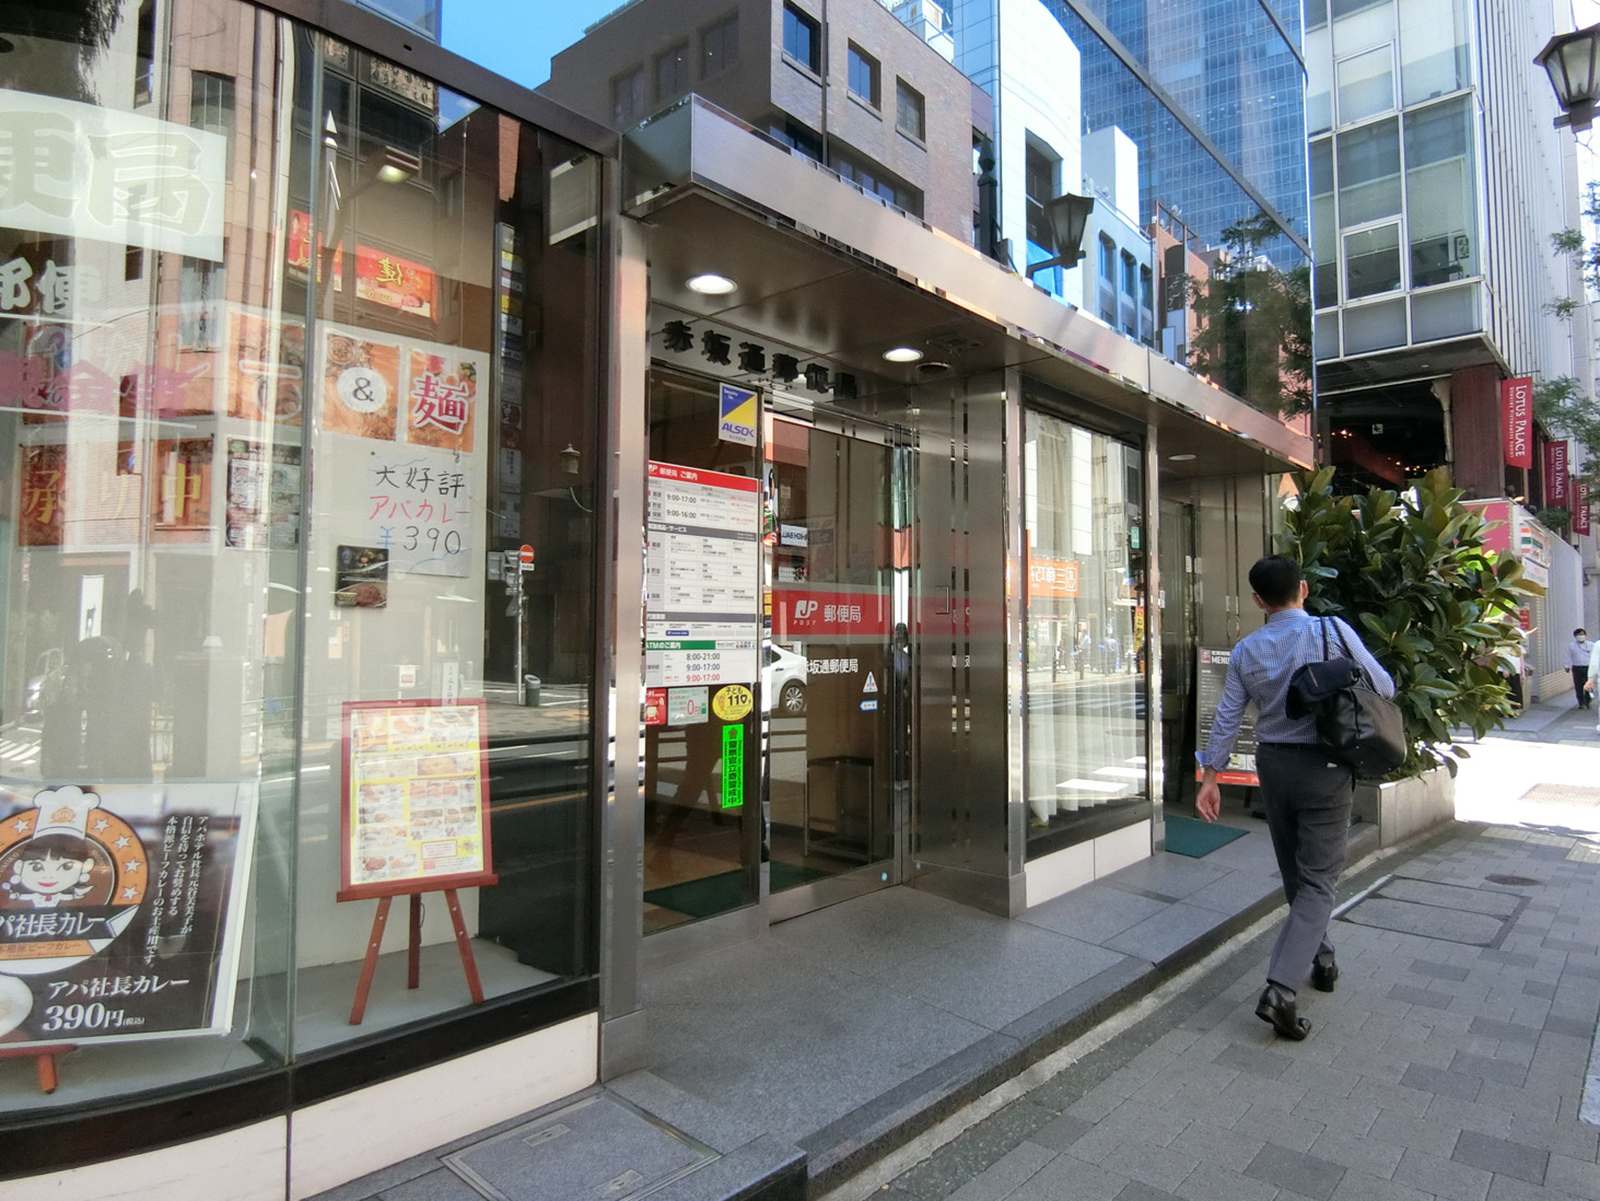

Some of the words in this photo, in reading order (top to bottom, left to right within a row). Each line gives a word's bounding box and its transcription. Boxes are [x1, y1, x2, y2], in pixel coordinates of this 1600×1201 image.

[412, 373, 470, 434] 麺
[1515, 385, 1527, 417] LOTUS
[721, 422, 755, 438] ALSOK
[1515, 420, 1527, 457] PALACE
[1555, 446, 1564, 470] LOTUS
[376, 466, 465, 499] 大好評
[1555, 472, 1564, 499] PALACE
[666, 493, 697, 504] 9:00-17:00
[666, 509, 697, 519] 9:00-16:00
[1579, 506, 1588, 529] PALACE
[823, 604, 862, 624] 郵便局
[686, 663, 720, 672] 9:00-17:00
[686, 673, 720, 683] 9:00-17:00
[726, 686, 743, 695] 子ども
[49, 976, 190, 1001] アパ社長カレー
[42, 1002, 125, 1032] 390円
